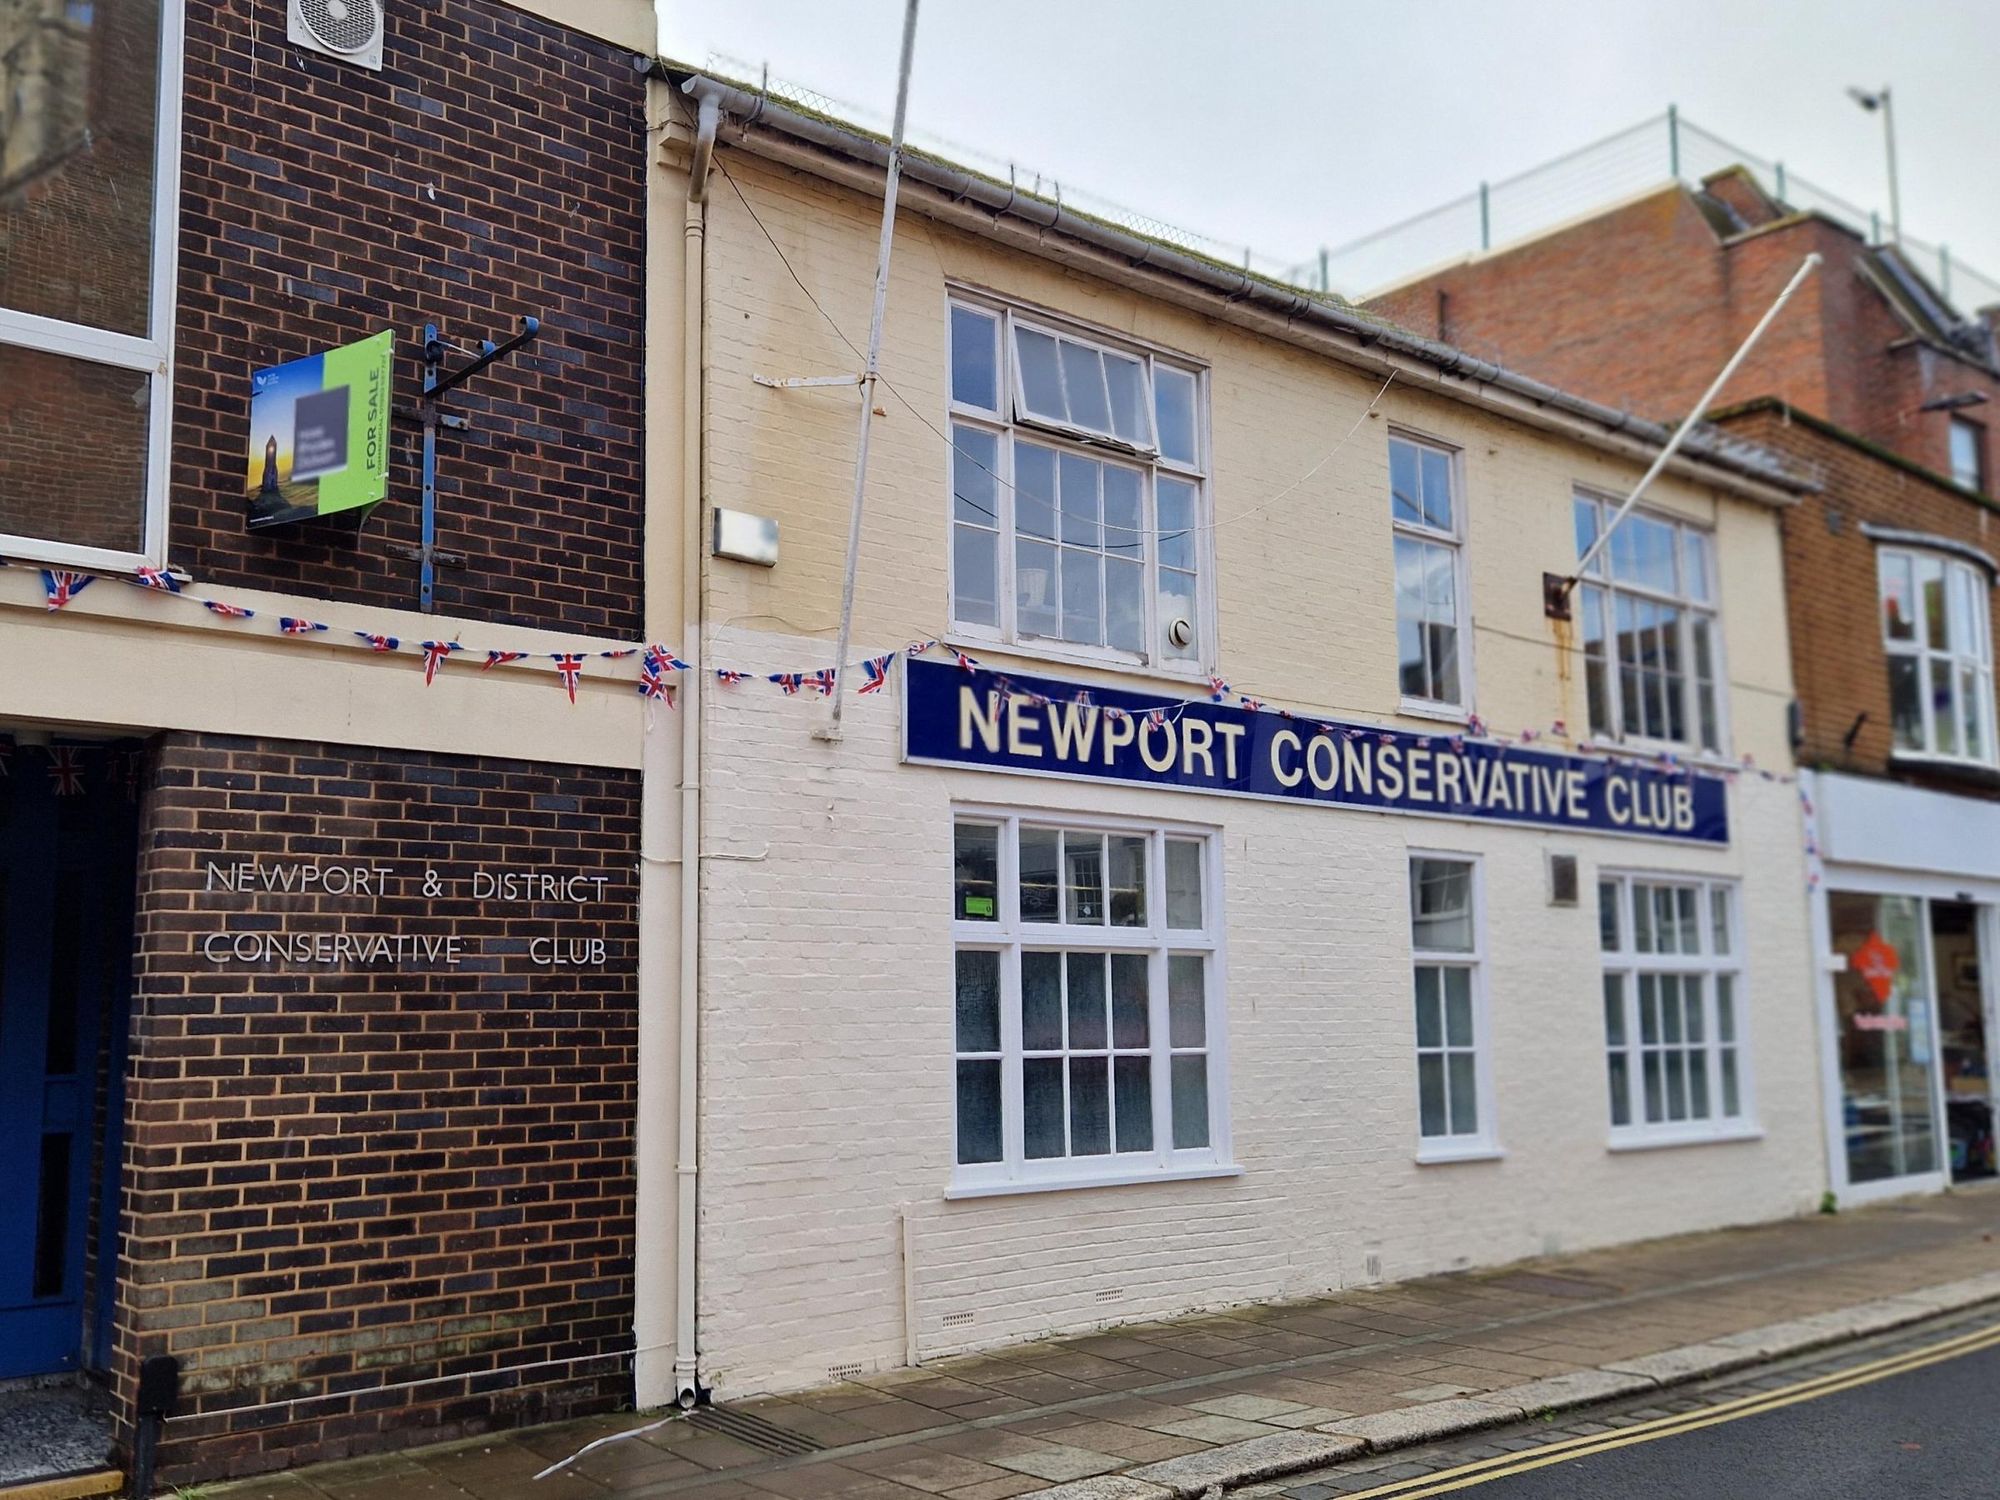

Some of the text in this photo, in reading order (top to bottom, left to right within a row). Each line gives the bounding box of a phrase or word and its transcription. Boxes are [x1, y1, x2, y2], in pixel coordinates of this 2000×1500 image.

[366, 367, 380, 470] FOR SALE
[959, 685, 1696, 831] NEWPORT CONSERVATIVE CLUB
[206, 861, 609, 903] NEWPORT & DISTRICT
[204, 932, 607, 965] CONSERVATIVE CLUB
